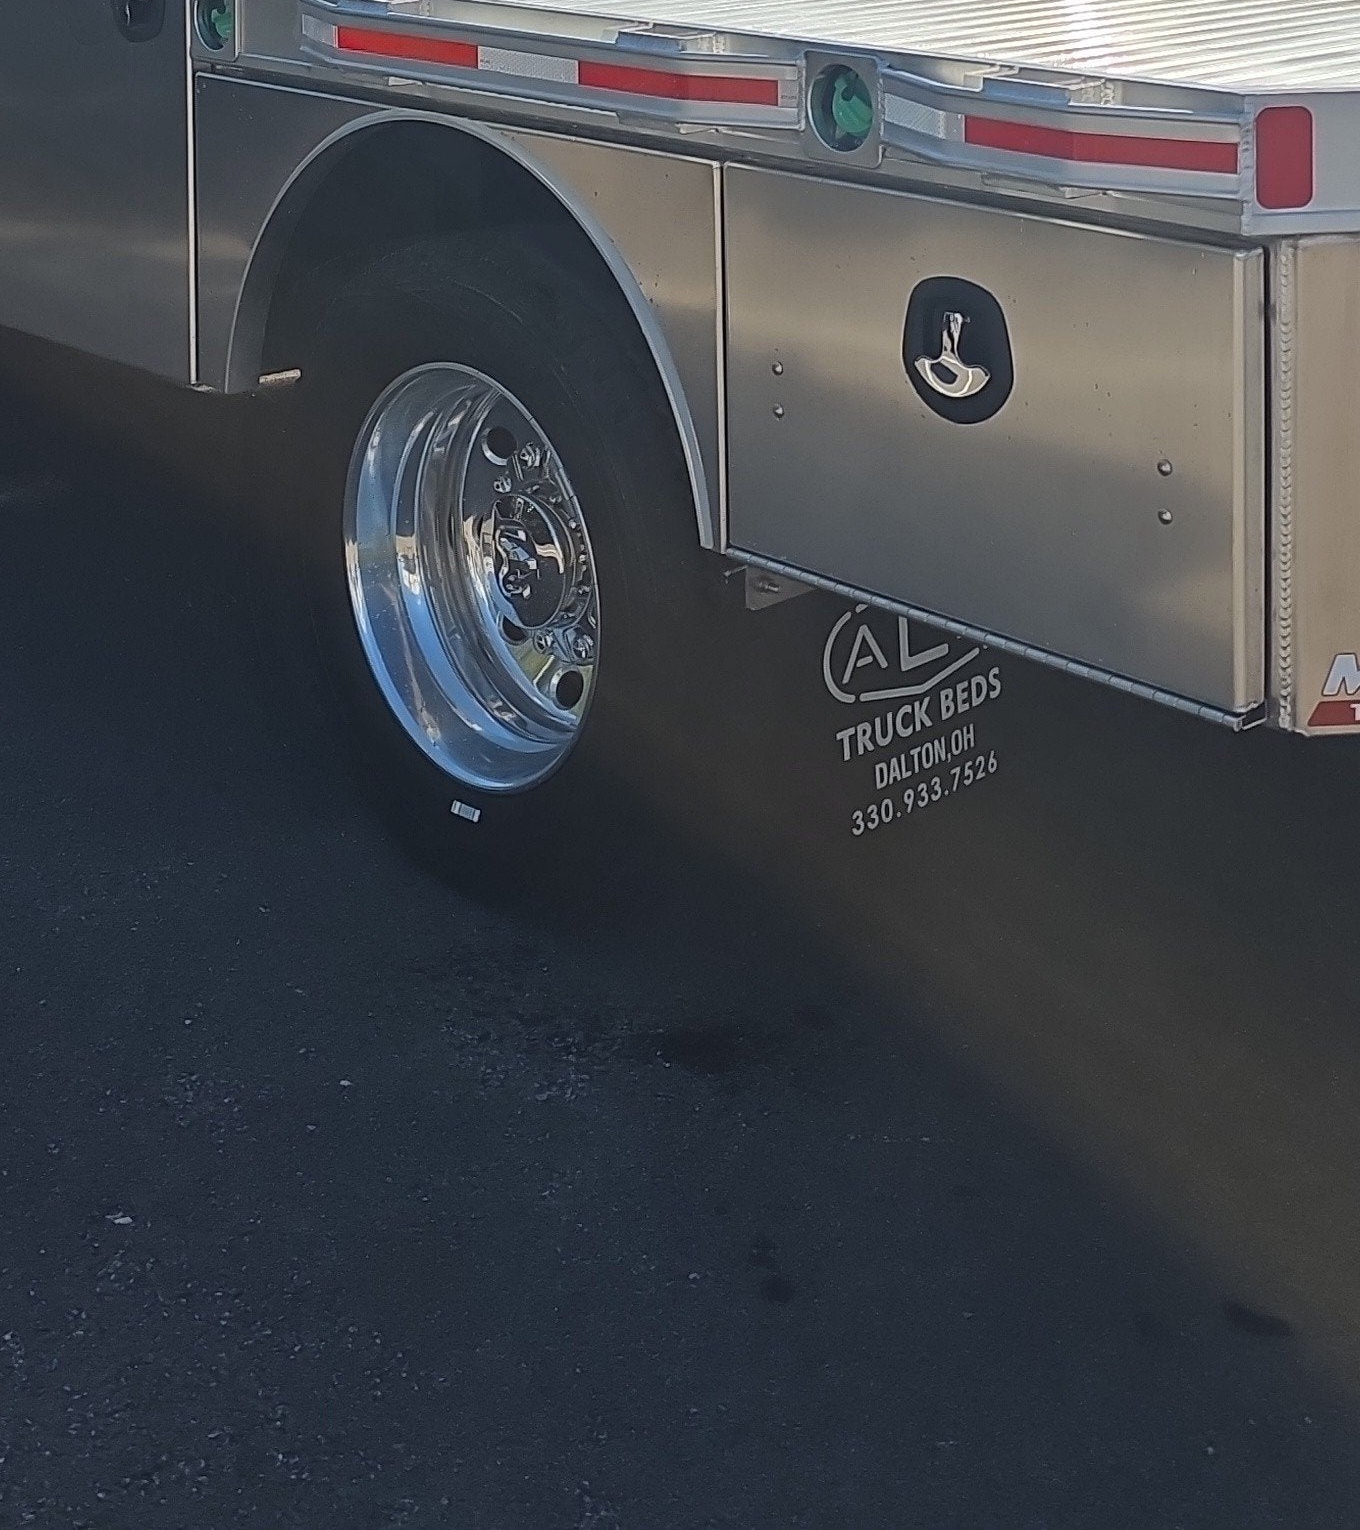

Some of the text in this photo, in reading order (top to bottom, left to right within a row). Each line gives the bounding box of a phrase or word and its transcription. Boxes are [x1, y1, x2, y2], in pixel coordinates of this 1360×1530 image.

[842, 615, 950, 685] AL
[836, 666, 1001, 761] TRUCK BEDS
[851, 750, 998, 836] 330.933.7526
[875, 723, 975, 790] DALTON,OH
